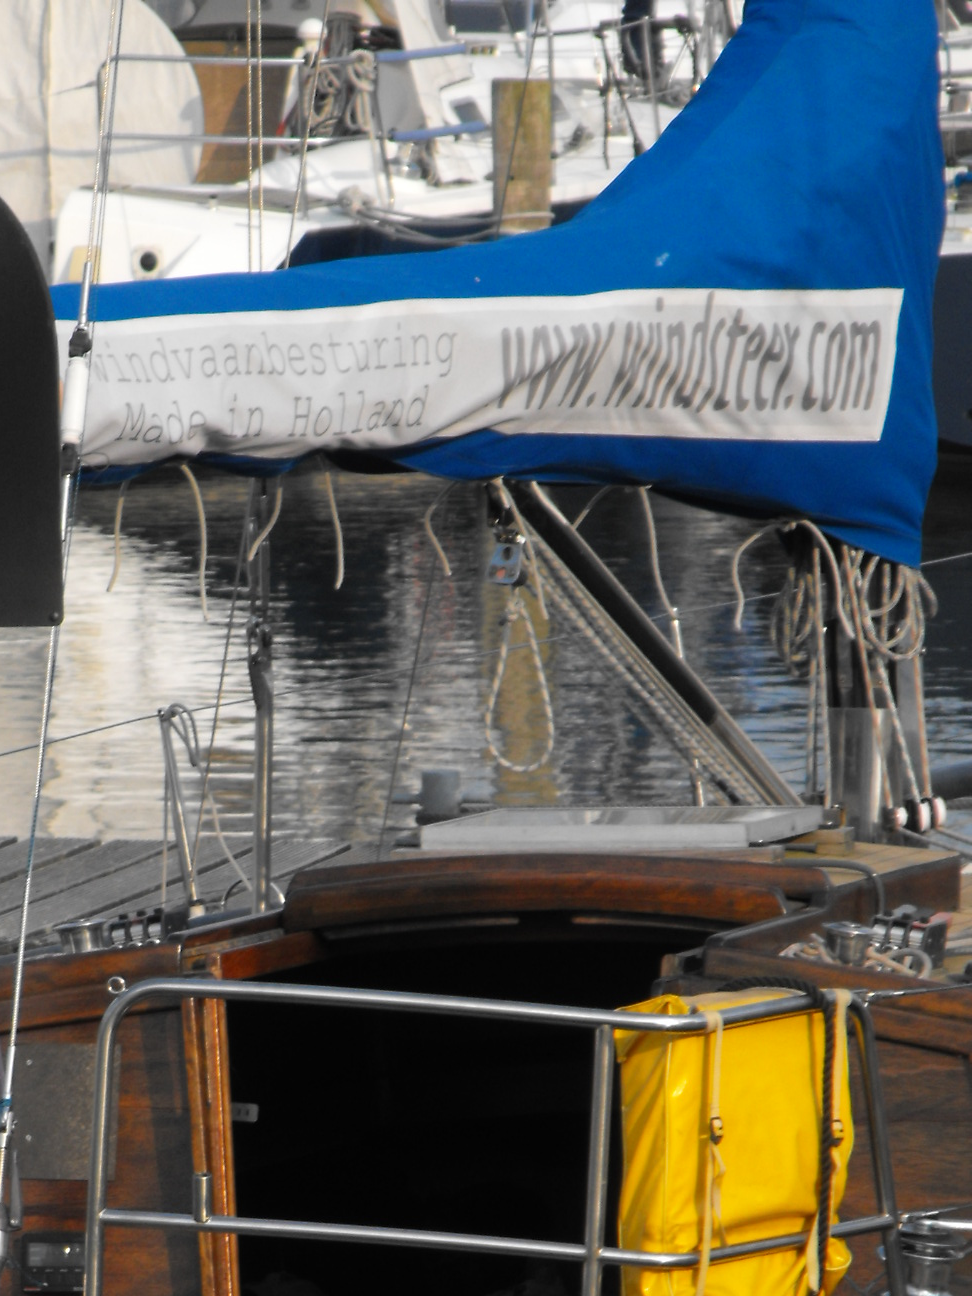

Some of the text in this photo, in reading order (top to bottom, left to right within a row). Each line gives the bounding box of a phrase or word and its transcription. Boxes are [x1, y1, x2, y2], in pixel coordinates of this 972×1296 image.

[93, 321, 458, 384] windvaanbesturing
[497, 290, 882, 413] www.windsteer.com
[114, 384, 429, 445] Made in Holland
